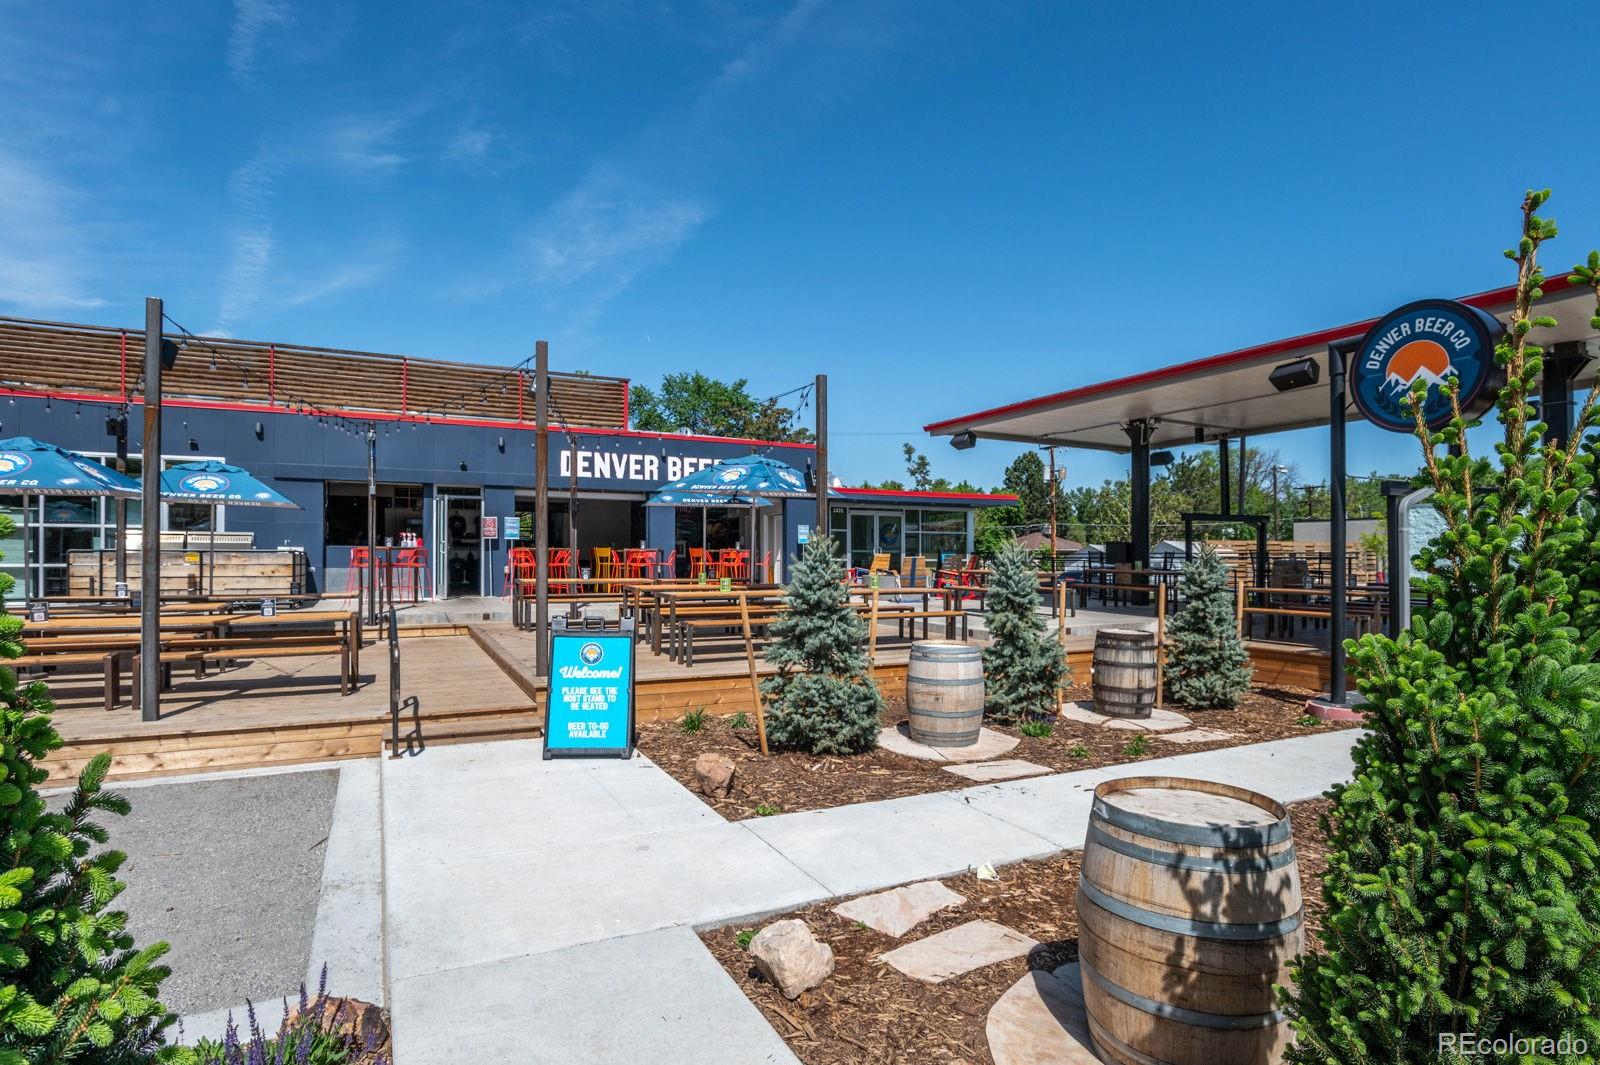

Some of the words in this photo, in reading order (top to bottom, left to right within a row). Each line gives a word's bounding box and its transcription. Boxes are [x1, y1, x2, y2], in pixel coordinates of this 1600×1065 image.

[1365, 322, 1411, 370] DENVER
[1414, 317, 1455, 338] BEER
[560, 450, 659, 481] DENVER
[559, 665, 623, 679] Welcome!
[562, 686, 589, 695] PLEASE
[590, 686, 603, 695] SEE
[605, 686, 618, 695] THE
[563, 694, 581, 703] HOST
[582, 694, 605, 703] STAND
[607, 694, 617, 703] TO
[570, 702, 581, 711] BE
[581, 702, 609, 711] SEATED
[567, 722, 586, 731] BEER
[588, 722, 610, 731] TO-GO
[568, 730, 607, 739] AVAILABLE
